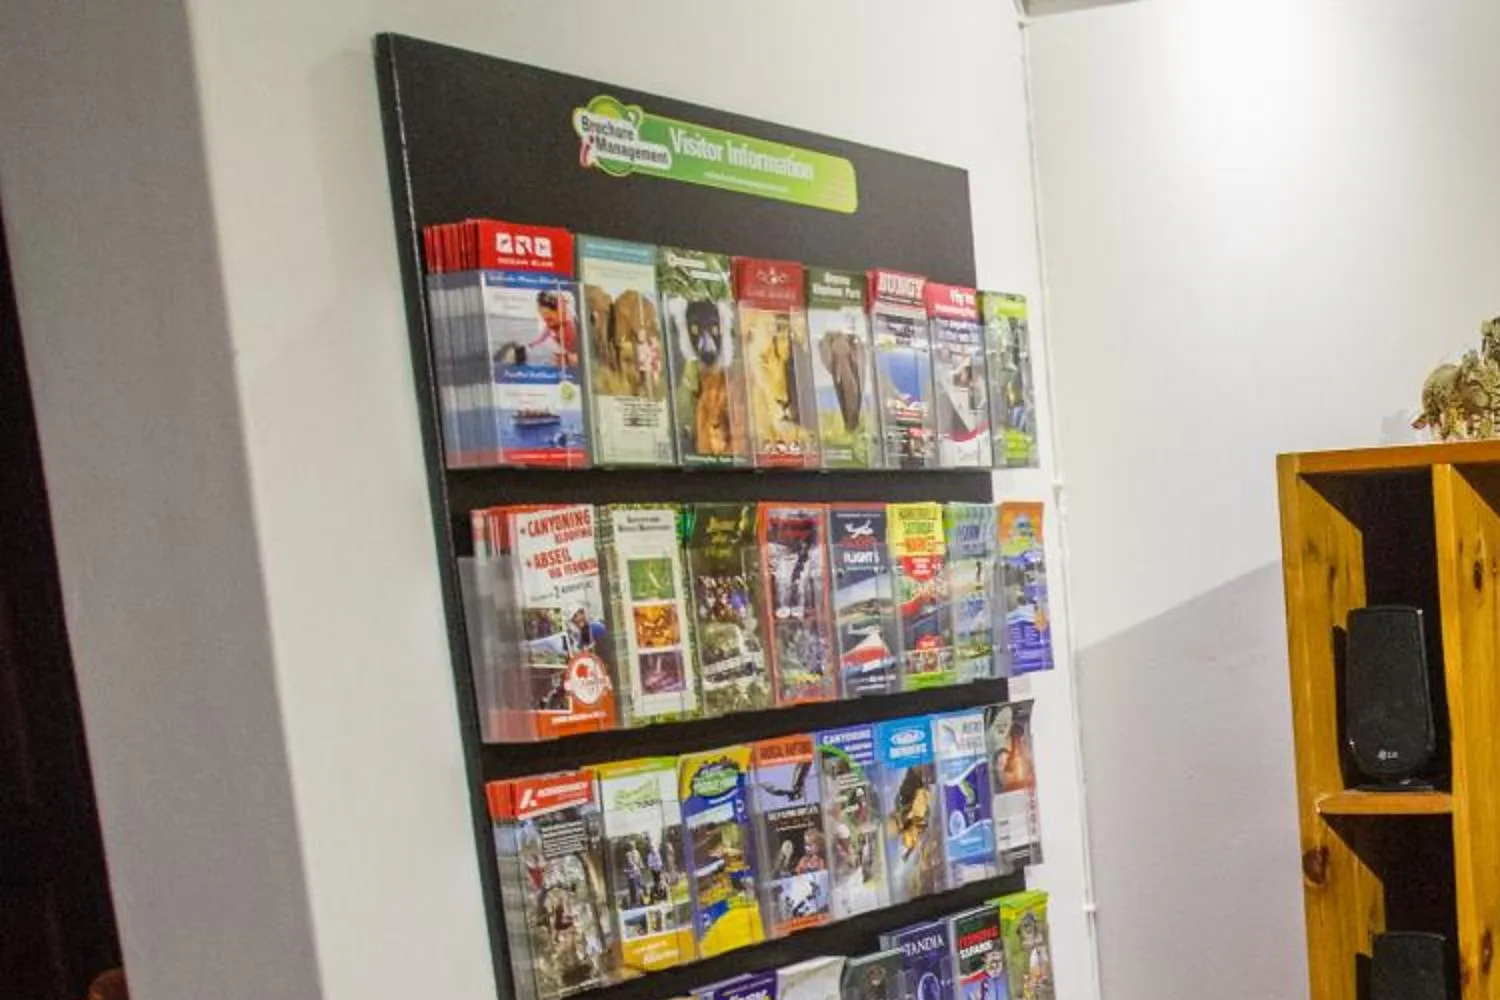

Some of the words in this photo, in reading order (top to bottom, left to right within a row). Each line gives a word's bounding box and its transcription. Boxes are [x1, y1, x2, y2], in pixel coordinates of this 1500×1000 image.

[594, 135, 669, 166] Management
[669, 127, 724, 163] Visitor
[726, 140, 815, 181] Information
[528, 510, 592, 537] CANYONING
